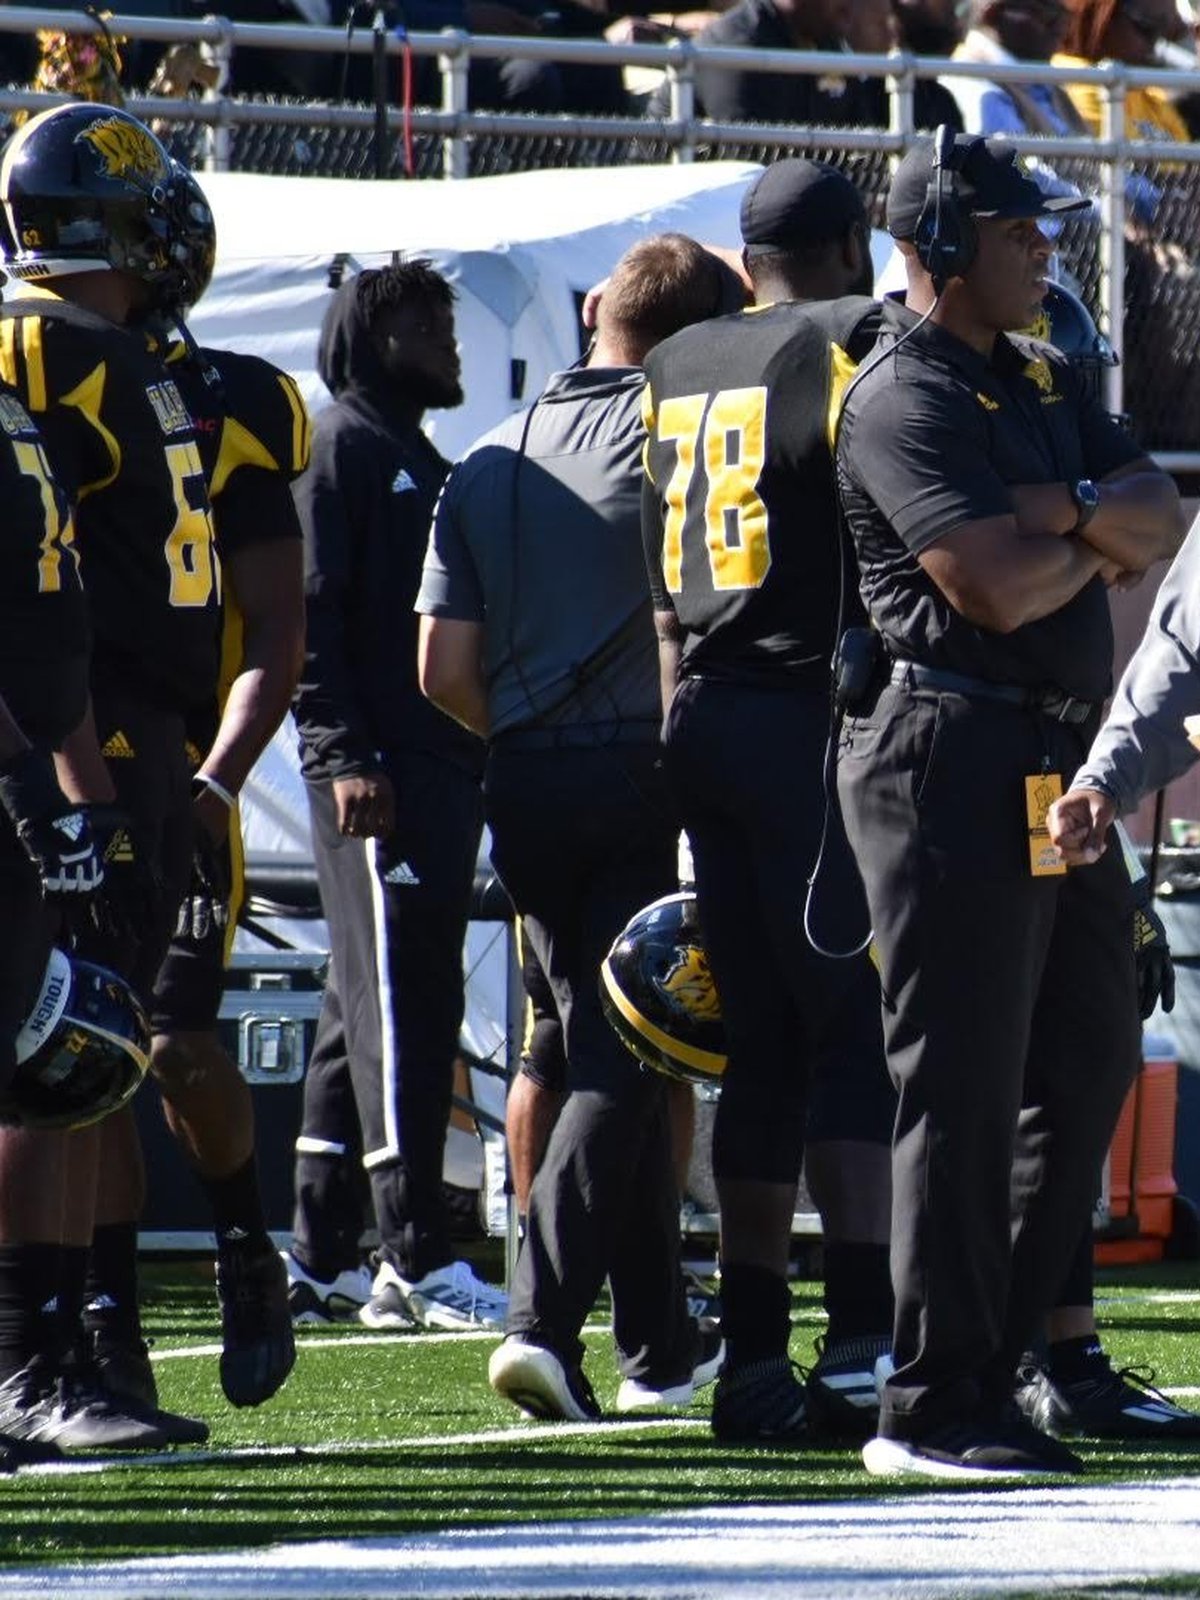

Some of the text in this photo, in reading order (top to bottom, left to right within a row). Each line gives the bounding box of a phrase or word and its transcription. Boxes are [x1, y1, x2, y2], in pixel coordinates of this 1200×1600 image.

[22, 229, 42, 247] 62
[657, 386, 772, 593] 78
[29, 976, 65, 1034] TOUGH
